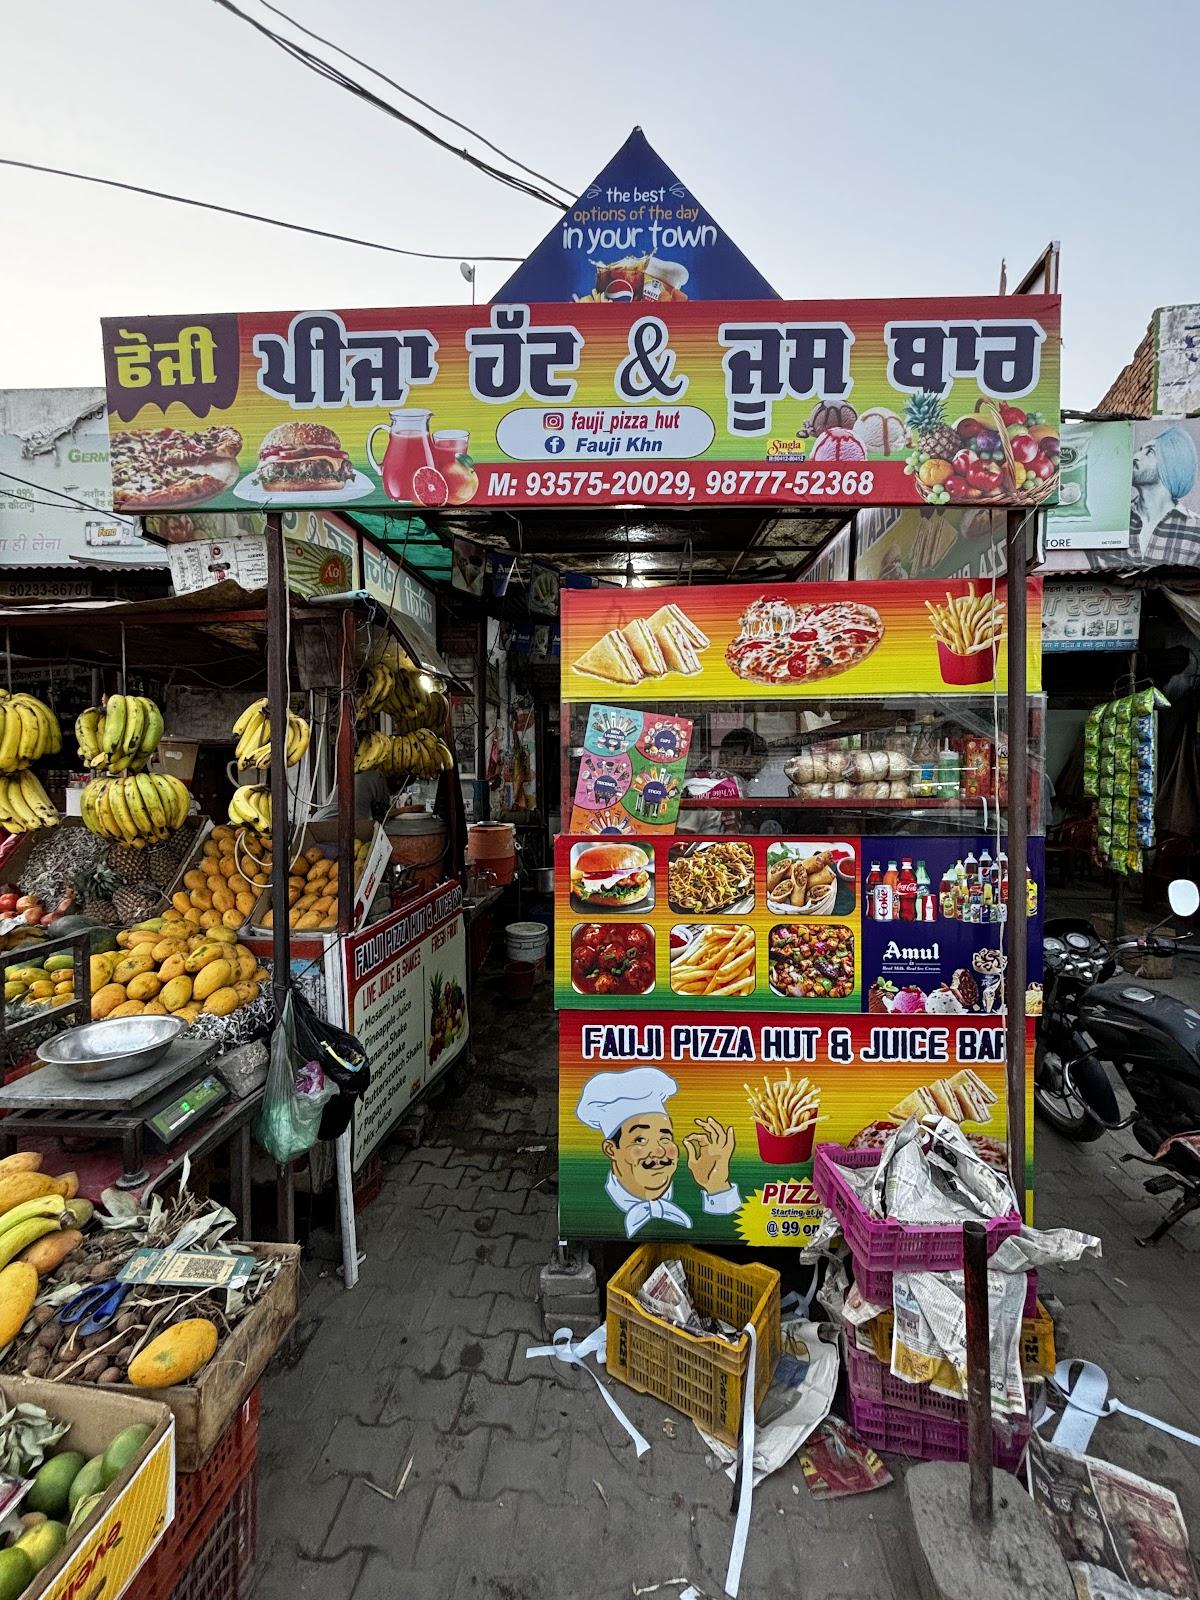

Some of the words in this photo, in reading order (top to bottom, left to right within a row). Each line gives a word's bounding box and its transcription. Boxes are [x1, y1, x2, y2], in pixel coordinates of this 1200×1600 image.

[606, 187, 630, 203] the
[633, 186, 666, 202] best
[573, 206, 626, 225] options
[629, 206, 646, 220] of
[649, 205, 673, 220] the
[676, 204, 699, 222] day
[562, 222, 583, 249] in
[587, 226, 644, 254] your
[648, 220, 717, 248] town
[254, 311, 438, 409] ਪੀਜਾ
[465, 304, 585, 404] ਹੱਟ
[614, 316, 689, 403] &
[718, 322, 855, 437] ਜੂਸ
[884, 319, 1046, 399] ਬਾਰ
[571, 410, 680, 435] fauji_pizza_hut
[68, 449, 110, 463] GERM
[576, 437, 620, 455] Fauji
[626, 437, 662, 452] Khn
[767, 439, 801, 455] Singla
[487, 473, 518, 496] M:
[526, 470, 696, 500] 93575-20029,
[705, 470, 875, 496] 98777-52368
[1046, 538, 1071, 548] TORE
[355, 932, 384, 981] FAUJI
[385, 917, 410, 958] PIZZA
[410, 907, 425, 940] HUT
[883, 941, 939, 961] Amul
[362, 982, 376, 1011] LIVE
[378, 966, 395, 998] JUICE
[402, 948, 421, 978] SHAKES
[364, 1000, 390, 1029] Mosami
[391, 987, 407, 1007] Juice
[364, 1016, 396, 1050] Pineapple
[397, 1000, 412, 1020] Juice
[367, 1041, 389, 1066] anana
[390, 1022, 408, 1042] Shake
[406, 1041, 423, 1063] Shake
[582, 1024, 664, 1060] FAUJI
[671, 1026, 755, 1061] PIZZA
[761, 1027, 821, 1063] HUT
[828, 1027, 854, 1063] &
[861, 1026, 949, 1063] JUICE
[370, 1060, 387, 1085] ango
[387, 1041, 406, 1063] Shake
[388, 1075, 407, 1100] Shake
[363, 1131, 375, 1150] Mix
[376, 1108, 392, 1134] Juice
[771, 1207, 804, 1219] Starting
[805, 1208, 815, 1217] at
[766, 1222, 780, 1237] @
[782, 1221, 800, 1236] 99
[802, 1222, 820, 1236] on
